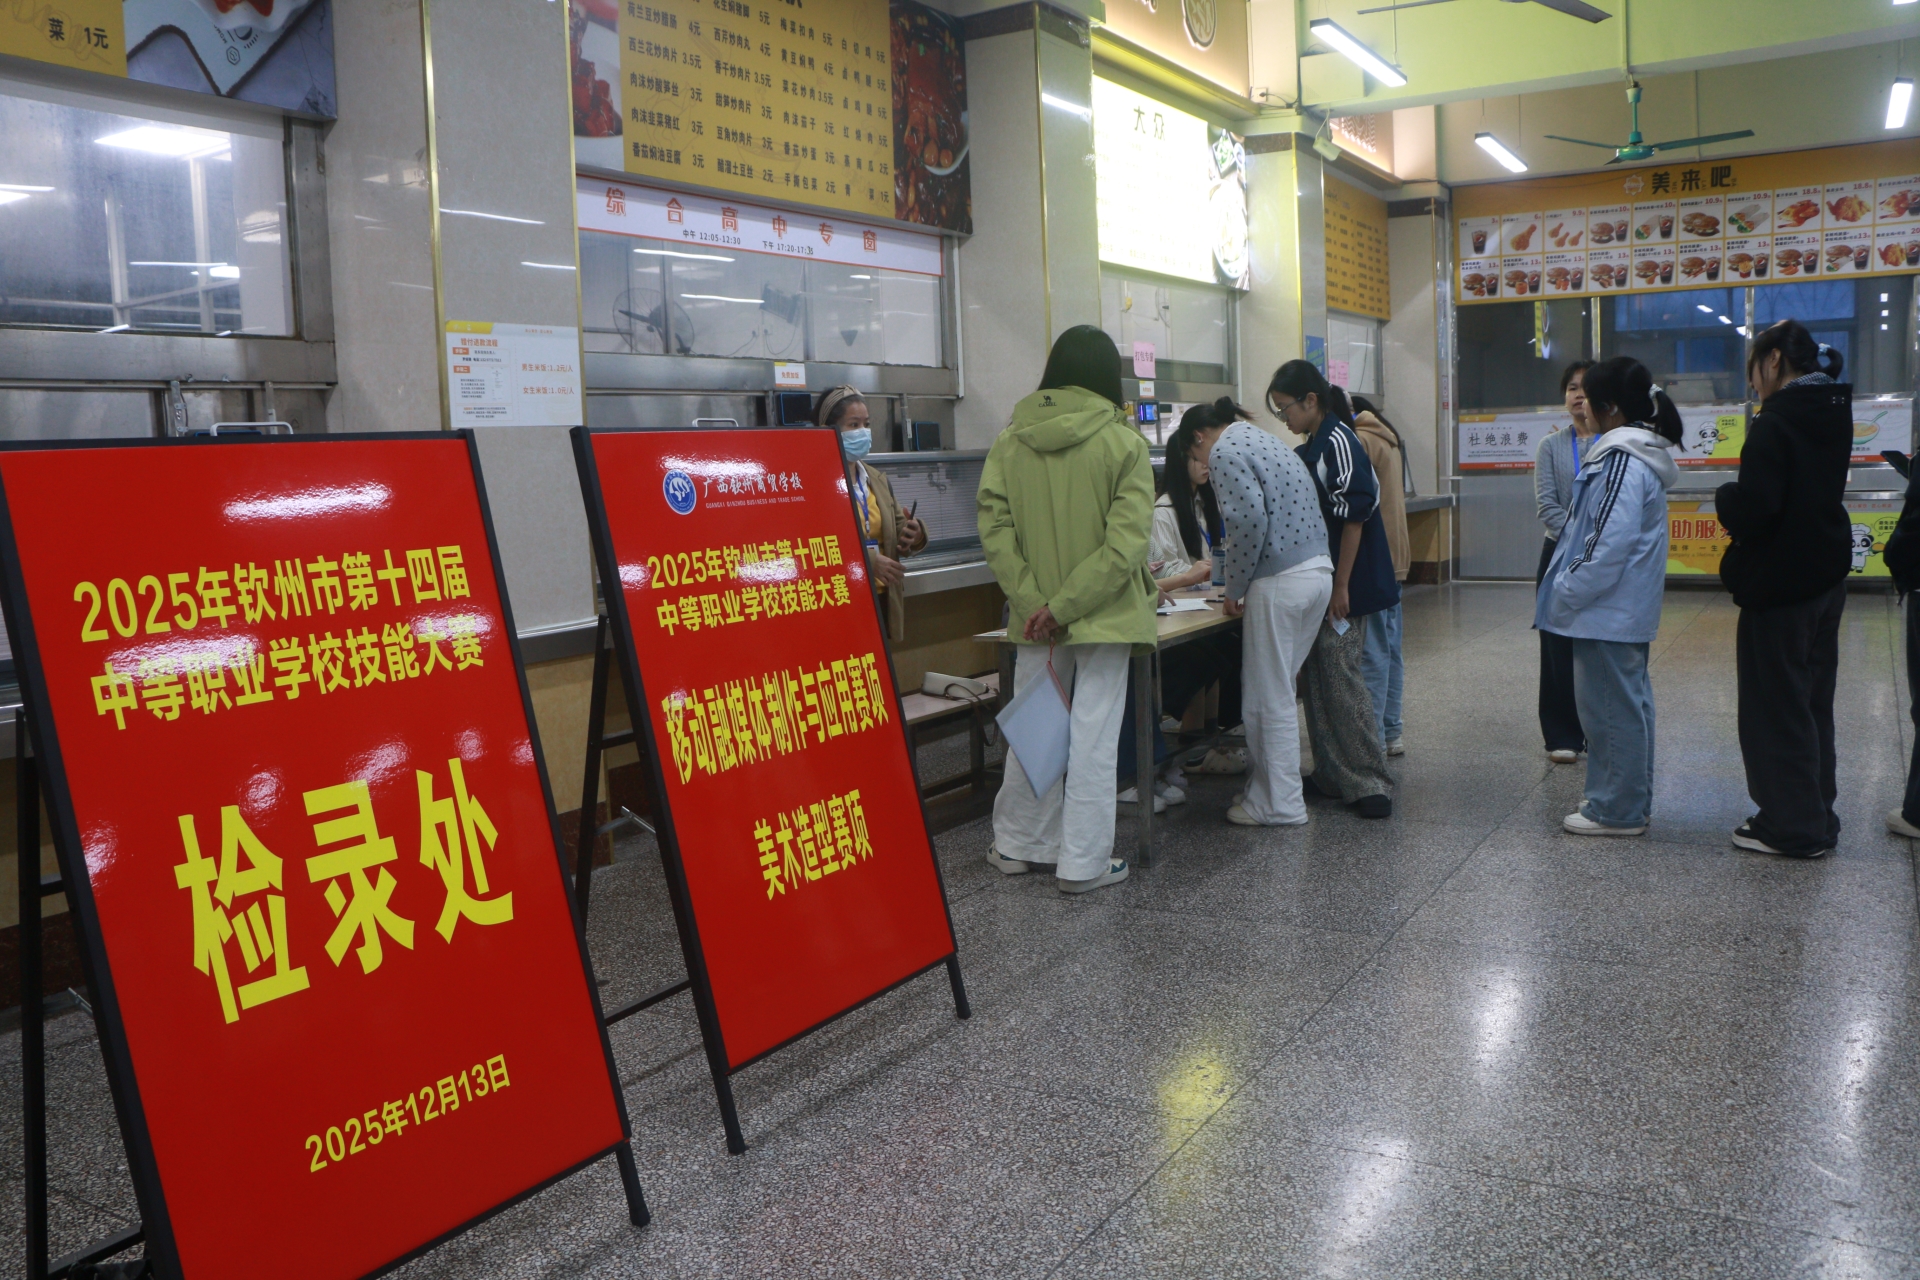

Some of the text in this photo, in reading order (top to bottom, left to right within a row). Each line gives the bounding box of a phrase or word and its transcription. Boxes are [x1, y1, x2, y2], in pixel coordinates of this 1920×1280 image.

[627, 1, 701, 36] 荷兰豆炒腊肠 4元
[759, 11, 770, 25] 5元
[48, 17, 109, 49] 菜 1元
[714, 27, 771, 57] 西芹炒肉丸 4元
[780, 17, 833, 46] 梅菜扣肉 5元
[628, 36, 702, 69] 西兰花炒肉片 3.5元
[781, 48, 834, 76] 黄豆焖鸭 4元
[841, 38, 886, 64] 白切鸡 5元
[715, 60, 771, 88] 香干炒肉片 3.5元
[877, 78, 886, 92] 5元
[691, 88, 702, 102] 3元
[782, 79, 834, 105] 菜花炒肉 3.5元
[715, 93, 772, 120] 甜笋炒肉片 3元
[878, 107, 887, 120] 5元
[692, 121, 703, 135] 3元
[783, 111, 835, 135] 肉沫茄子 3元
[716, 126, 773, 150] 豆角炒肉片 3元
[843, 126, 888, 148] 红烧肉 5元
[632, 142, 704, 168] 番茄焖油豆腐 3元
[784, 142, 835, 165] 番茄炒蛋 3元
[763, 169, 773, 183] 2元
[879, 162, 889, 175] 2元
[1652, 165, 1731, 195] 美来吧
[784, 172, 836, 194] 手撕包菜 2元
[880, 191, 889, 203] 1元
[605, 186, 878, 253] 综合高中专窗
[683, 229, 741, 245] 中午 12:05-12:30
[762, 240, 774, 250] 下午
[1468, 431, 1528, 446] 杜绝浪费
[647, 534, 843, 589] 2025年钦州市第十四届
[73, 545, 471, 643] 2025年钦州市第十四届
[656, 574, 850, 636] 中等职业学校技能大赛
[91, 613, 484, 730] 中等职业学校技能大赛
[662, 652, 889, 785] 移动融媒体制作与应用赛项
[753, 789, 873, 901] 美术造型赛项
[174, 757, 514, 1024] 检录处
[304, 1053, 511, 1173] 2025年12月13日
